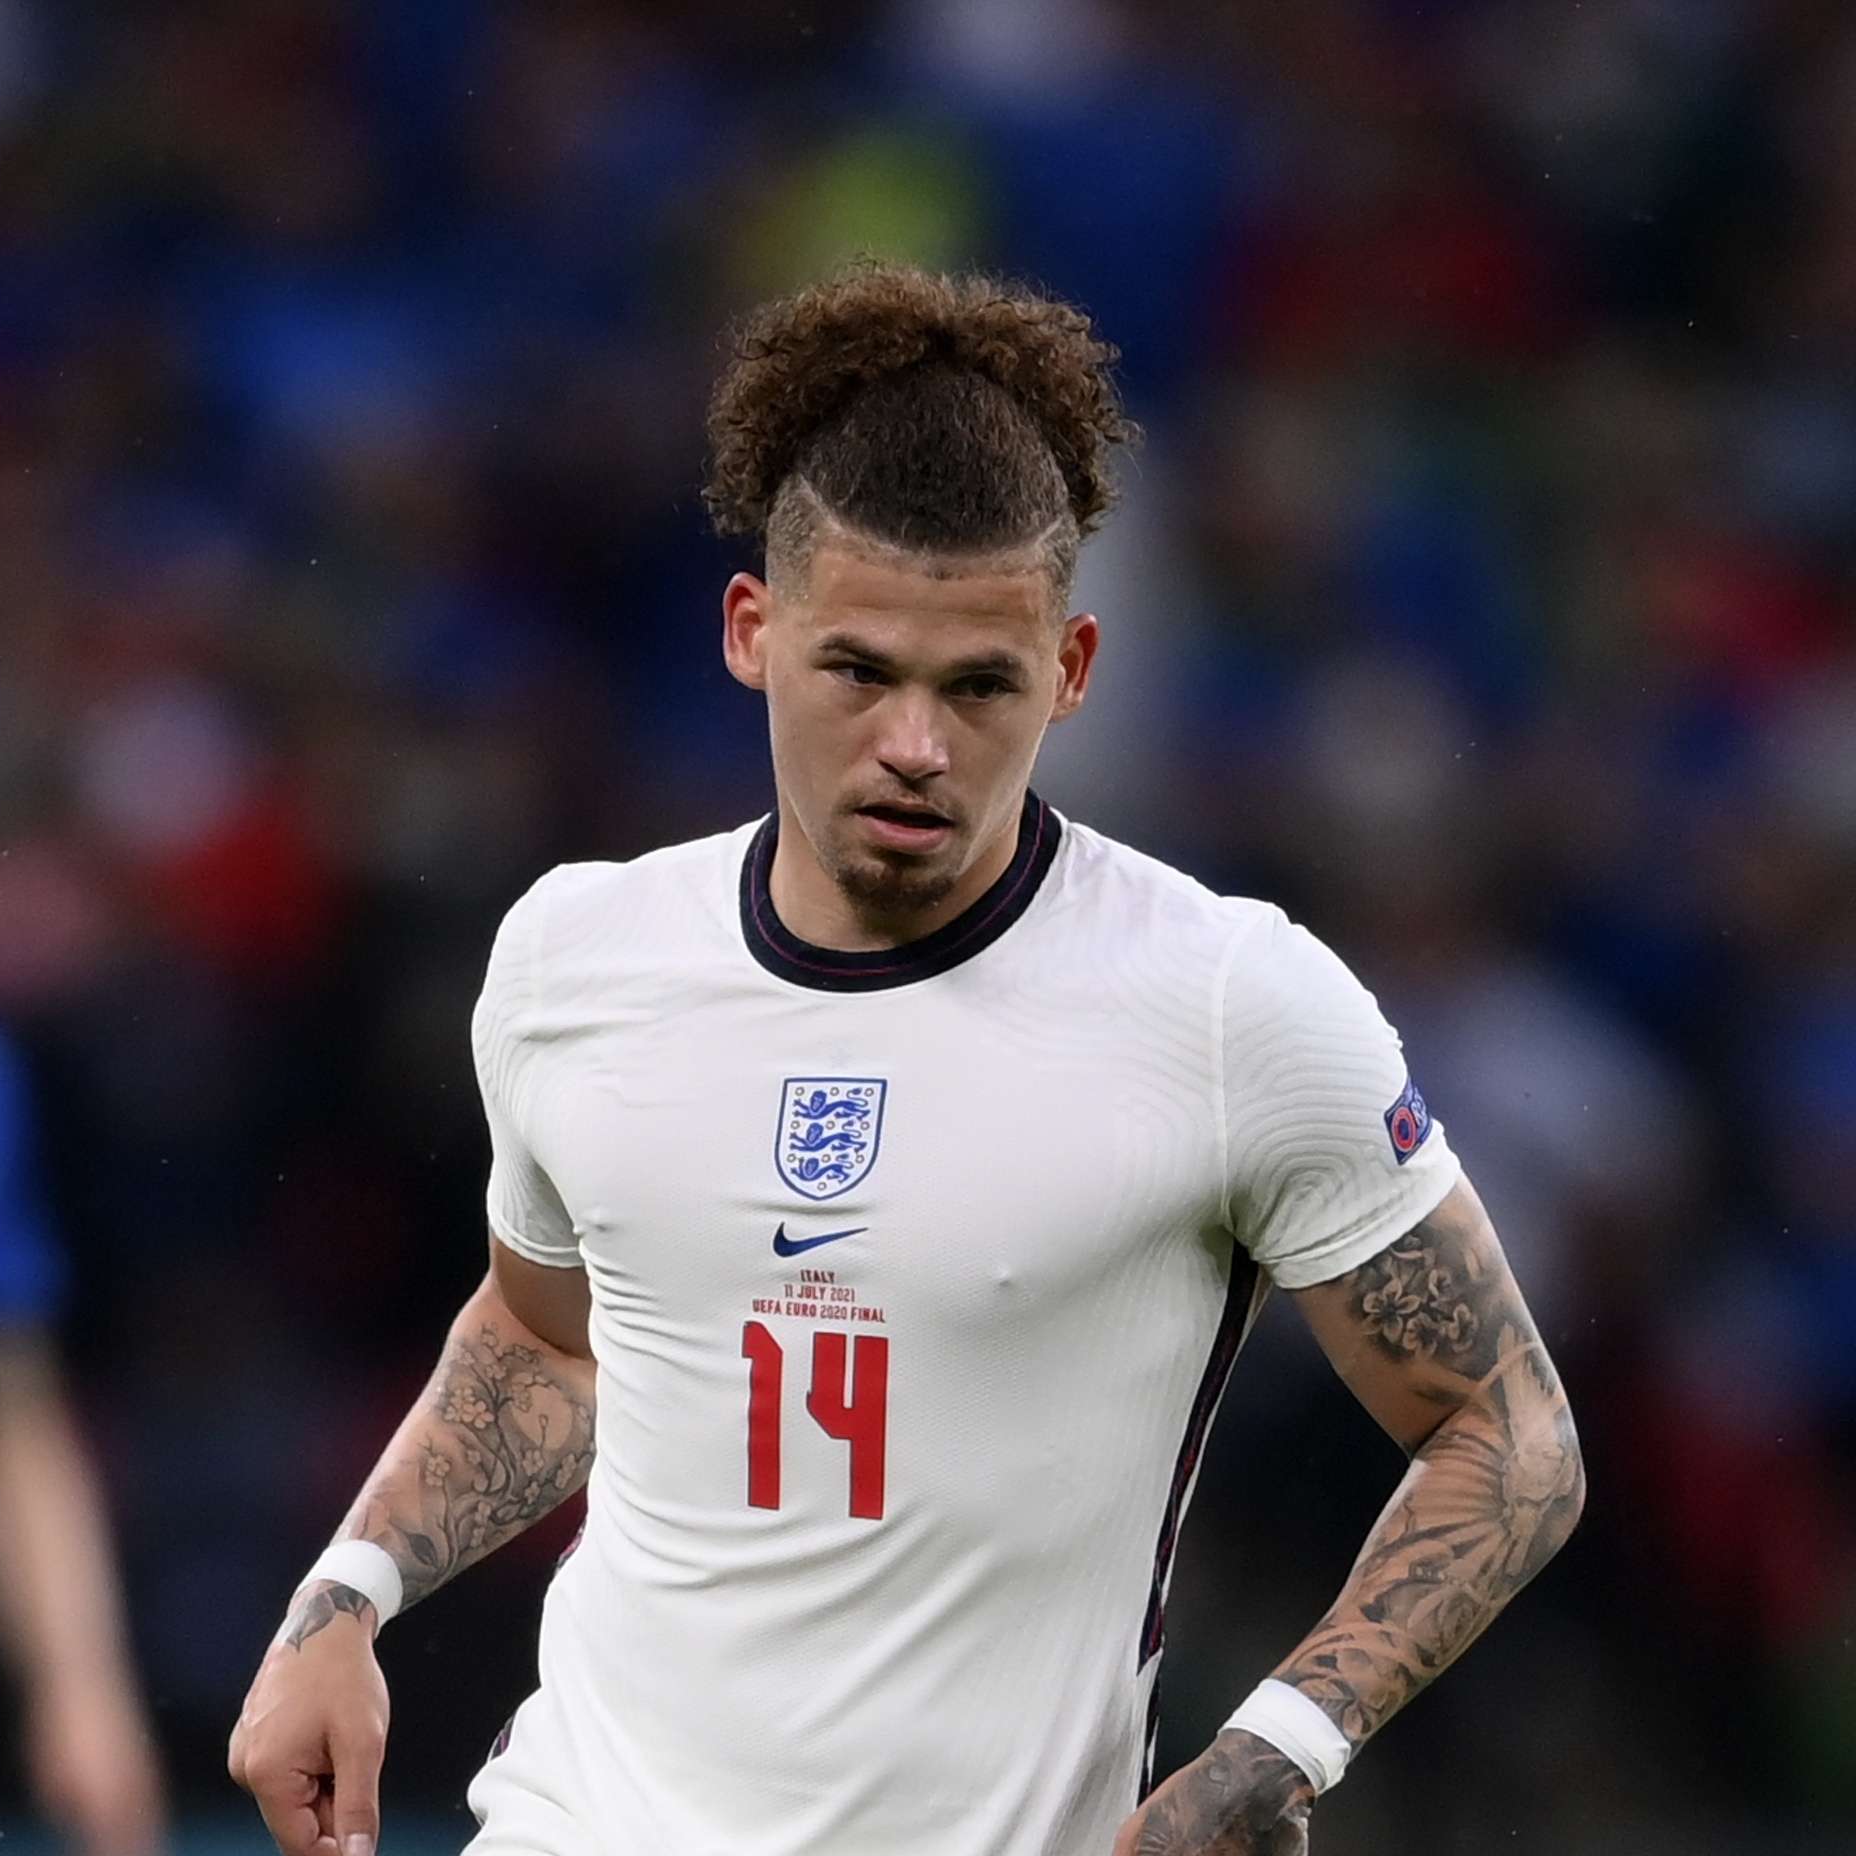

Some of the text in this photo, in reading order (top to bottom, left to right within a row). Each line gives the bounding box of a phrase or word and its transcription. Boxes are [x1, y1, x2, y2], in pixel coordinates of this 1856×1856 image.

[800, 1269, 835, 1284] ITALY
[784, 1284, 855, 1302] 11 JULY 2021
[752, 1299, 886, 1324] UEFA EURO 2020 FINAL
[742, 1320, 888, 1520] 14
